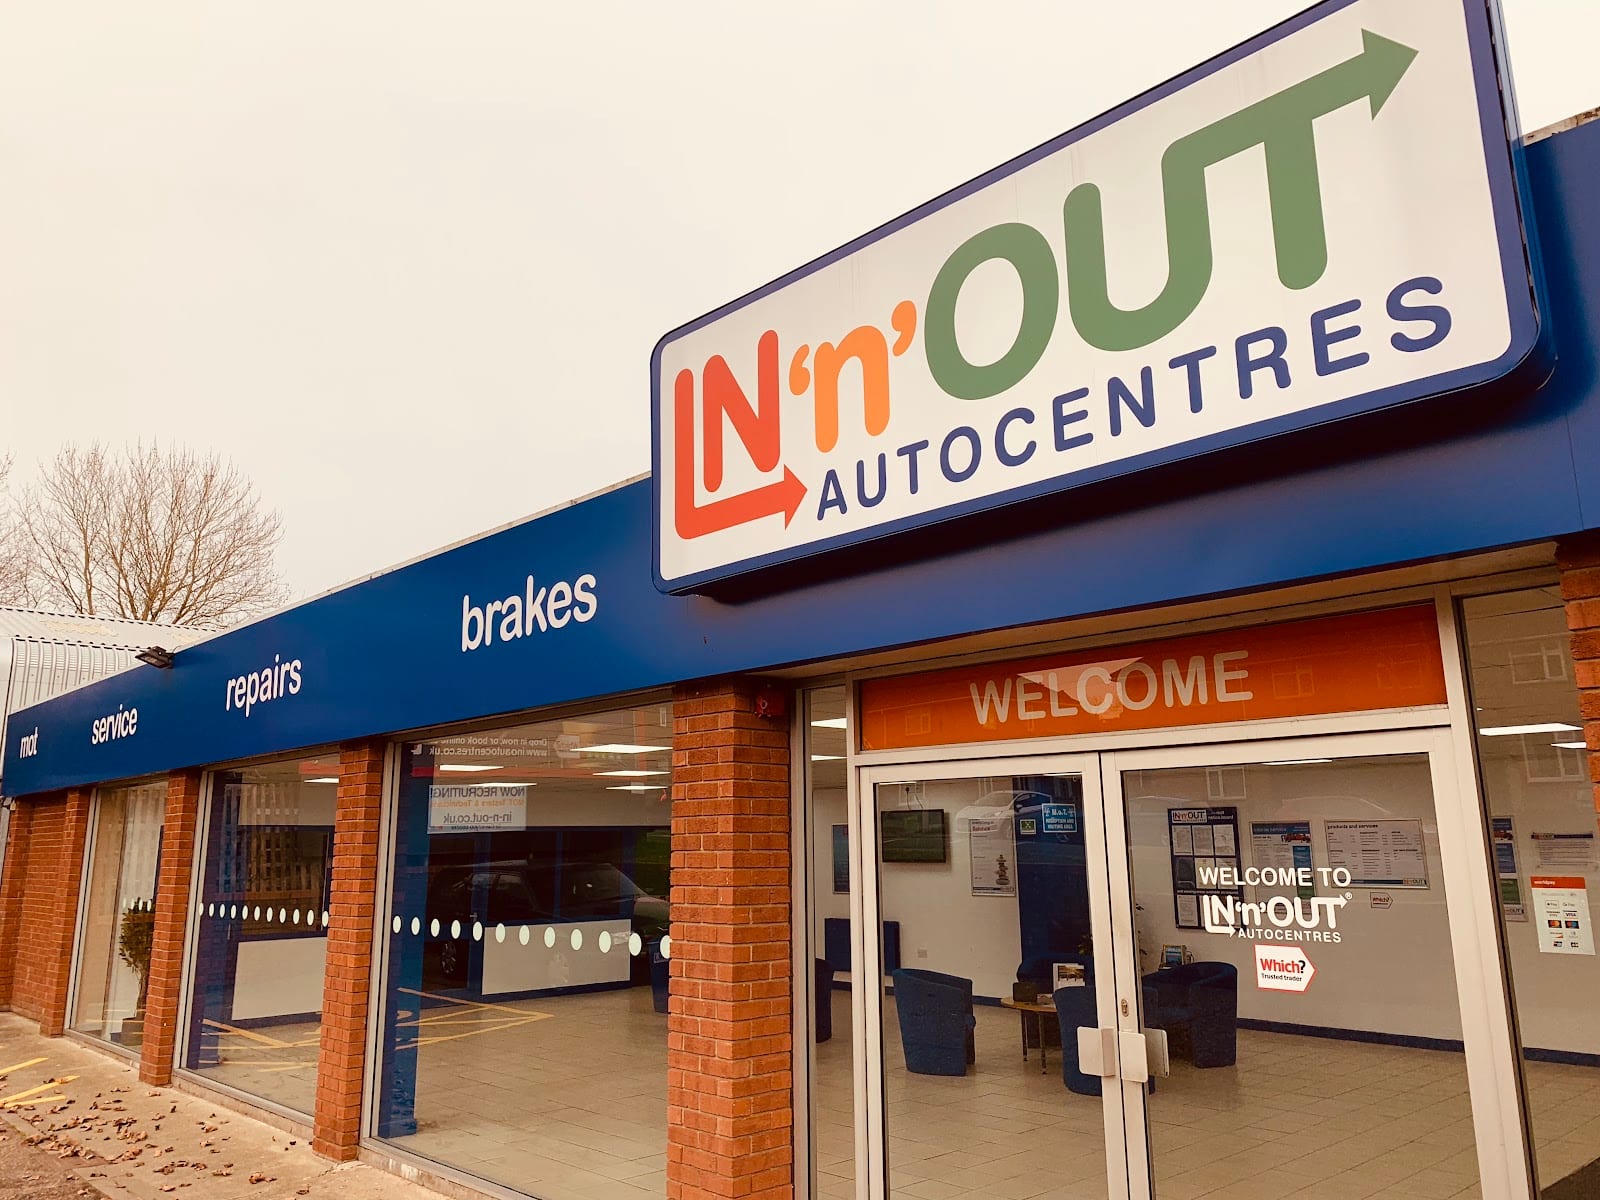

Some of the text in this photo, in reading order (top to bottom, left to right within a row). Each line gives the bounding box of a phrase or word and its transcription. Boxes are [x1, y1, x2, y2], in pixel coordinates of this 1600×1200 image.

[816, 276, 1452, 521] AUTOCENTRES
[461, 573, 597, 652] brakes
[226, 654, 302, 717] repairs
[969, 650, 1254, 725] WELCOME
[91, 704, 138, 745] service
[20, 727, 38, 759] mot
[1199, 867, 1351, 887] WELCOME TO
[1238, 928, 1342, 943] AUTOCENTRES
[1260, 958, 1306, 974] Which?
[1261, 973, 1302, 982] Trusted trader
